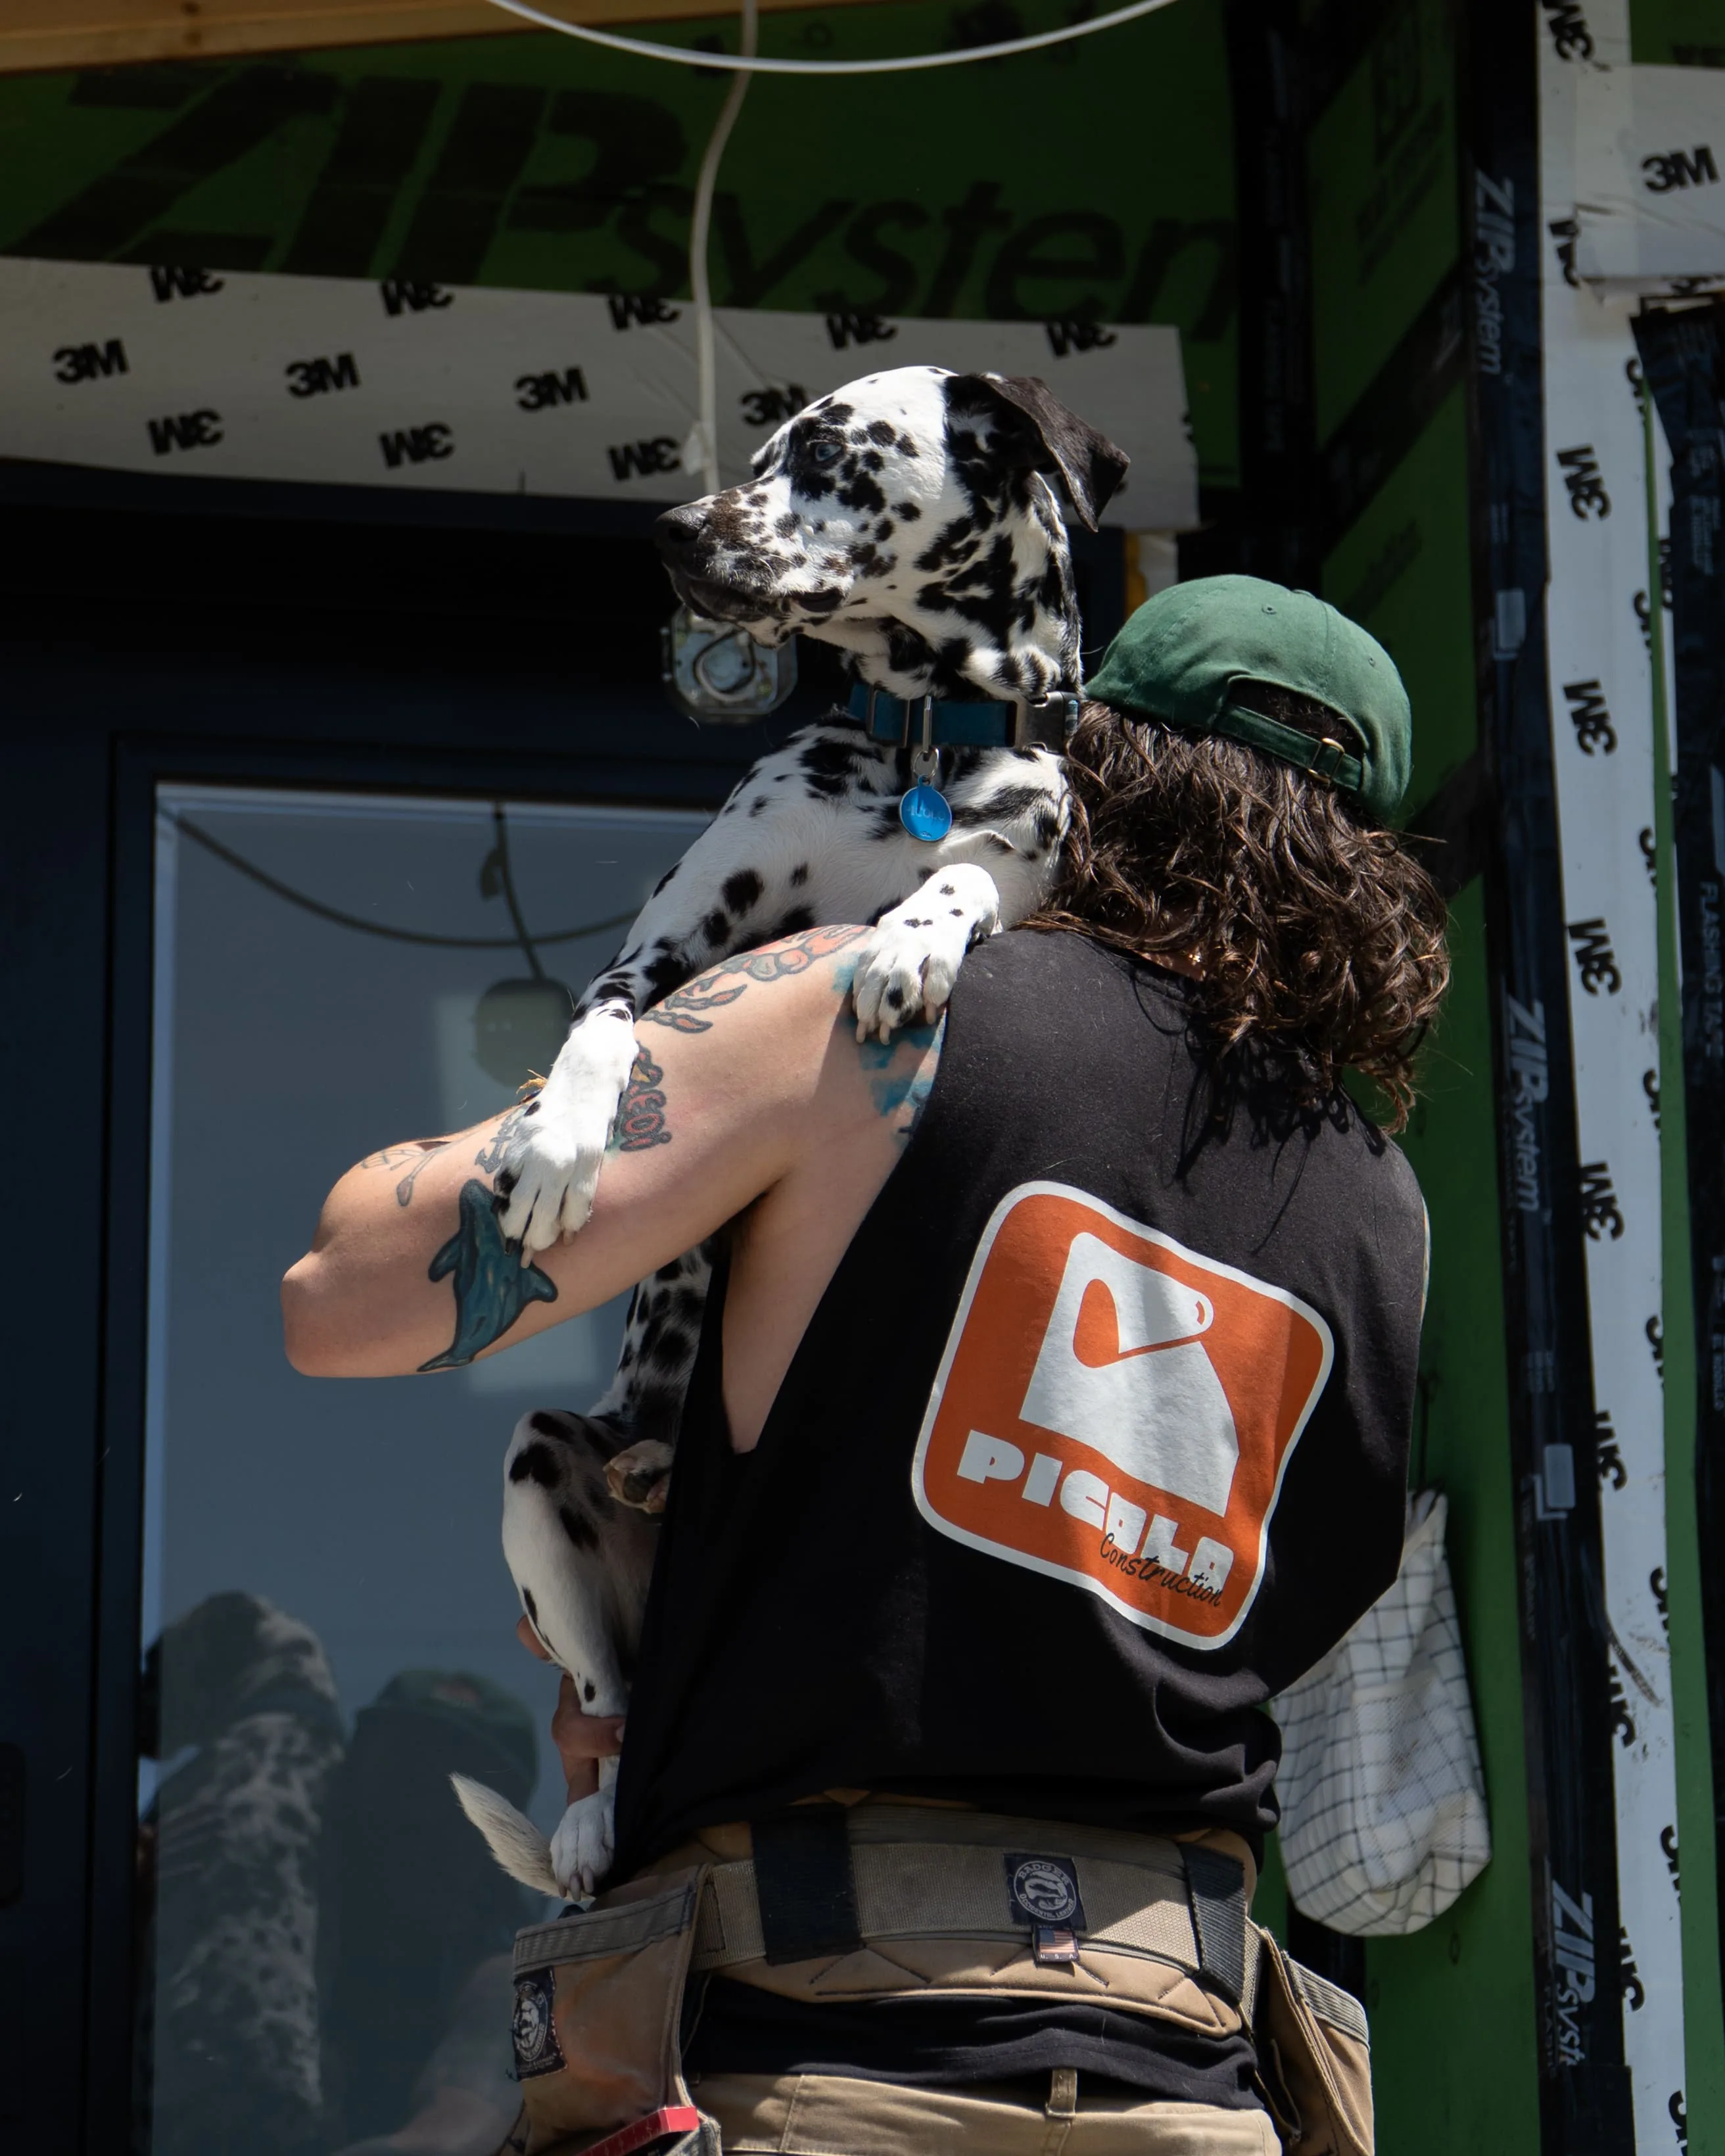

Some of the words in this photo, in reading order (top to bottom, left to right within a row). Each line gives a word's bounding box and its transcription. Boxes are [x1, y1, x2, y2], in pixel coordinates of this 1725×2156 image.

[1642, 148, 1718, 193] 3M
[54, 340, 128, 384] 3M
[285, 351, 360, 398] 3M
[516, 368, 588, 411] 3M
[741, 385, 808, 425] 3M
[147, 409, 224, 456] 3M
[379, 423, 456, 468] 3M
[609, 437, 680, 480] 3M
[1557, 444, 1611, 521] 3M
[1563, 679, 1617, 757] 3M
[1567, 918, 1622, 995] 3M
[1580, 1162, 1624, 1242] 3M
[1100, 1532, 1223, 1606] Construction
[1018, 1863, 1071, 1885] BADGER
[1551, 1878, 1596, 2004] ZIP
